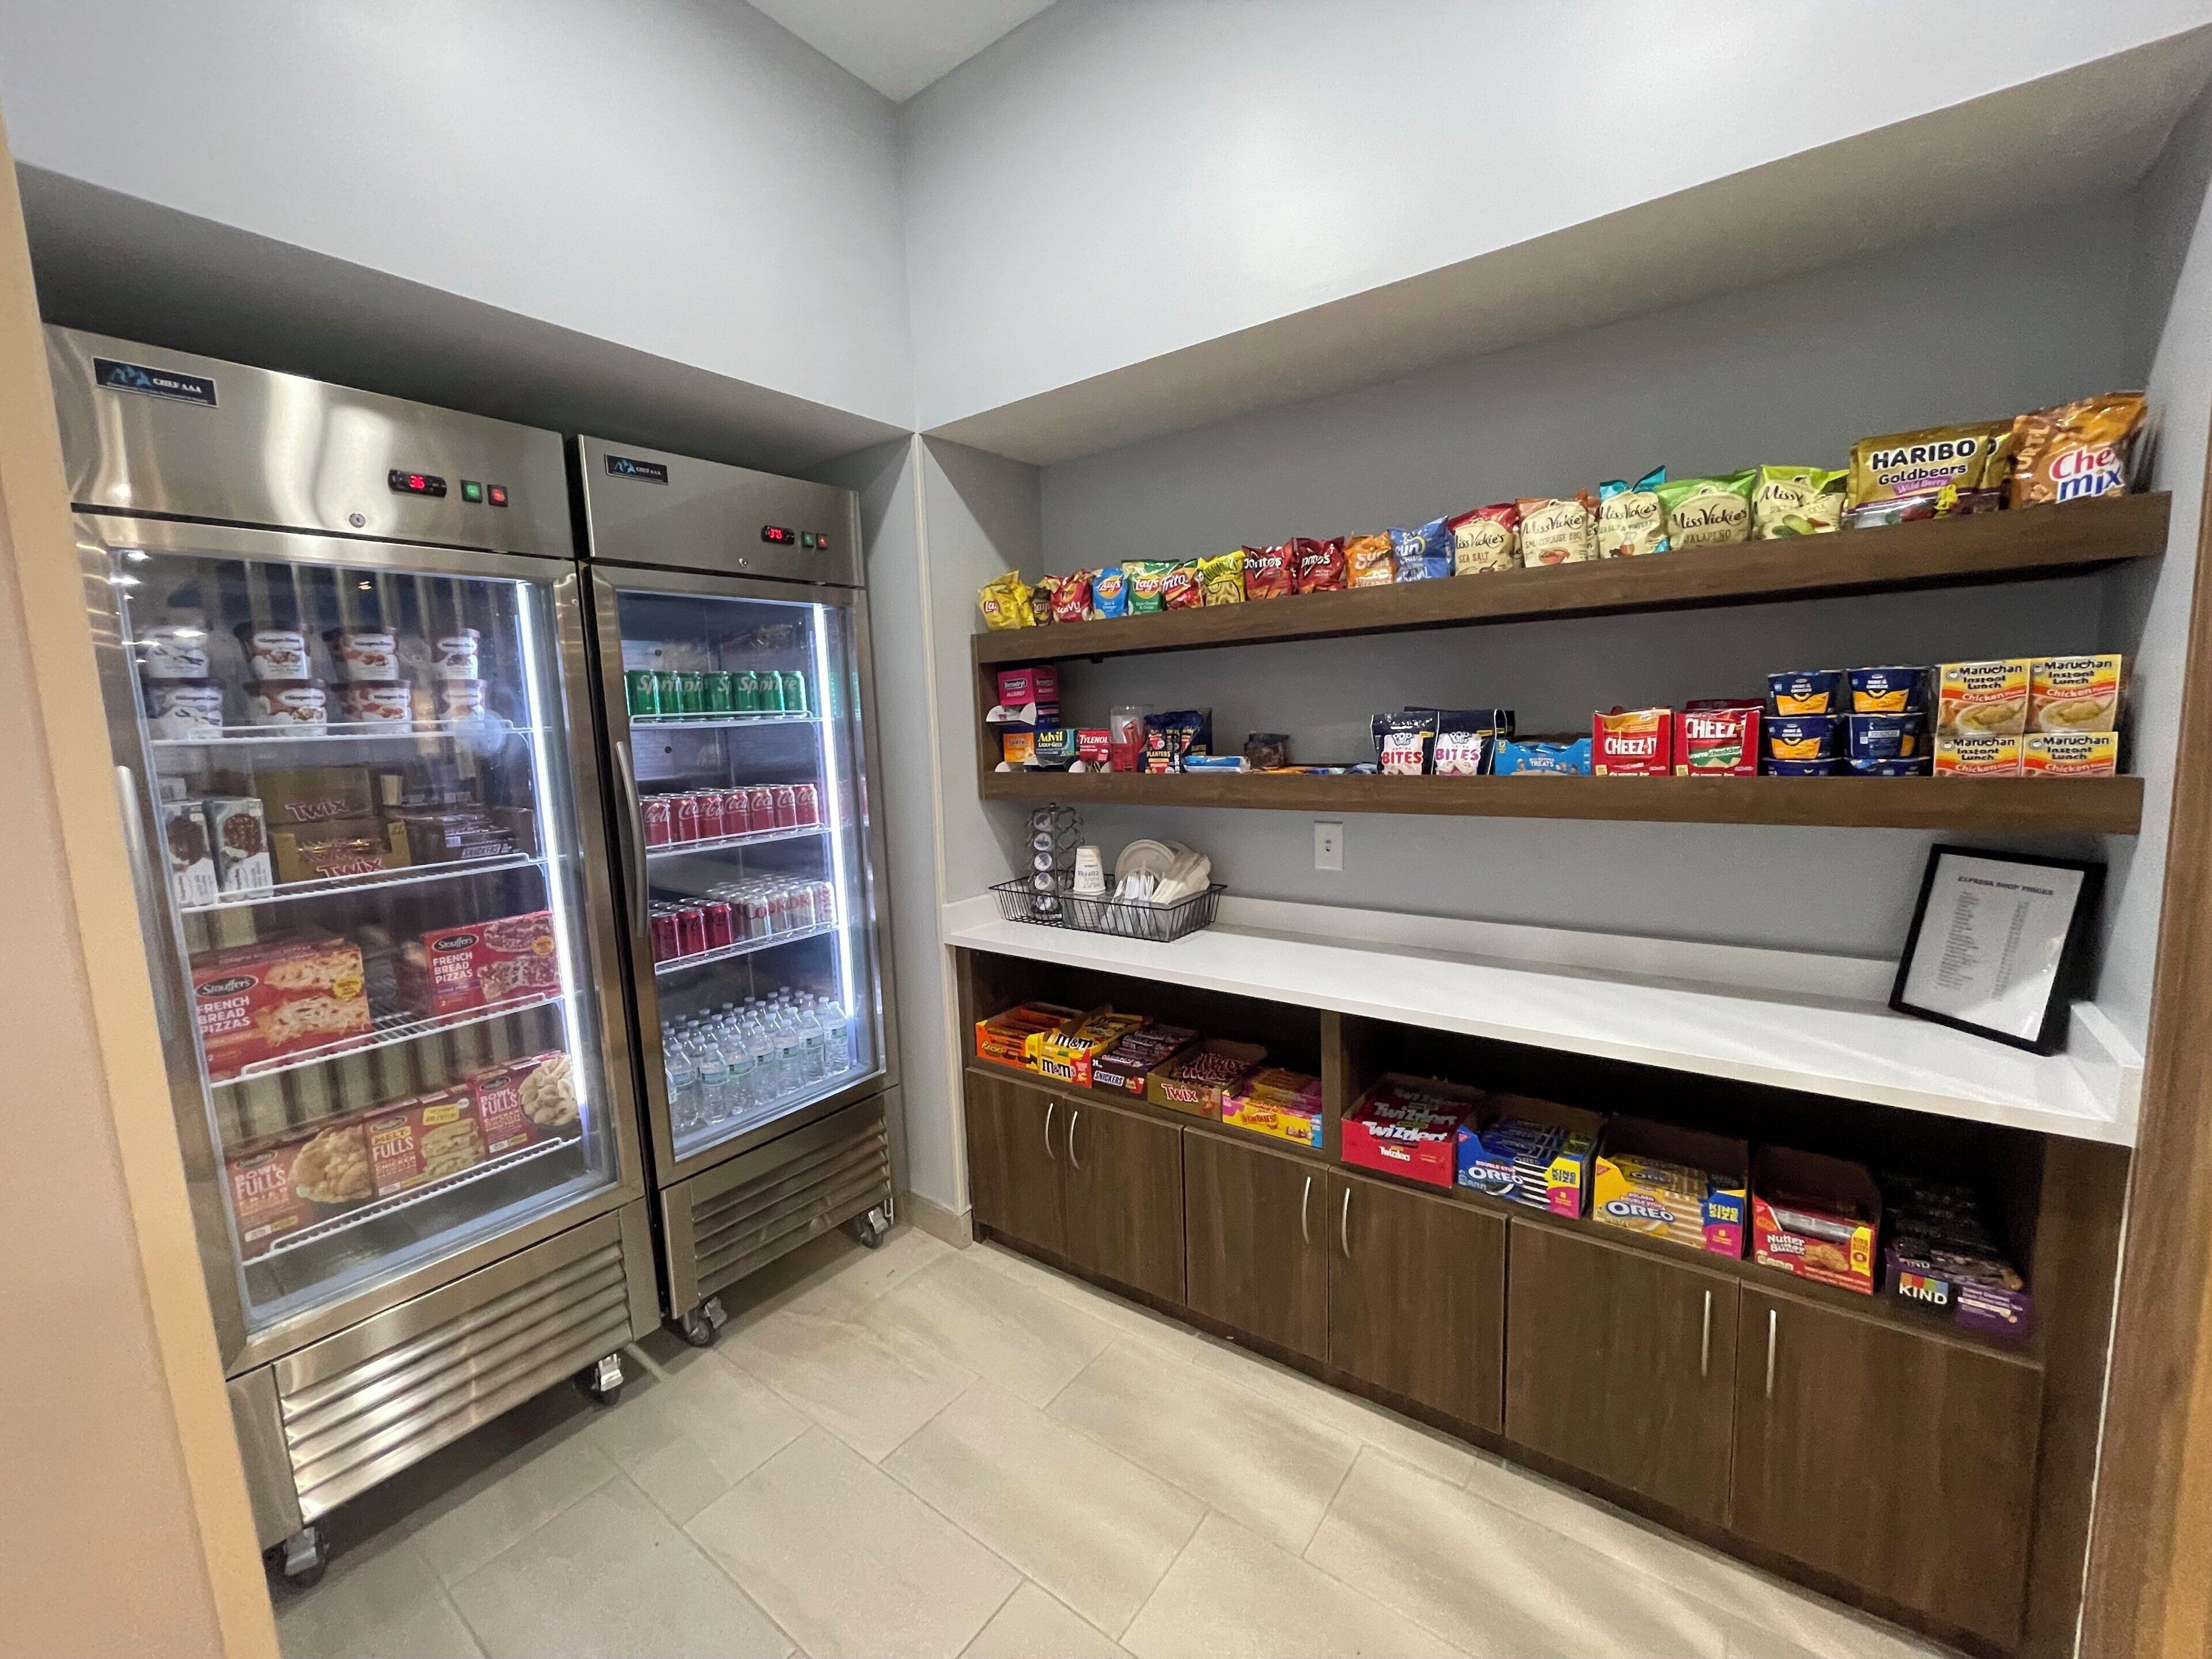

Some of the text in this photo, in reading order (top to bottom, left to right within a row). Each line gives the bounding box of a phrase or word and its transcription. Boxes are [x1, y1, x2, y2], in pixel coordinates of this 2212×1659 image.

[1872, 439, 1976, 471] HARIBO
[1878, 463, 1967, 486] Goldbears
[1897, 477, 1948, 495] Wild Berry
[2060, 467, 2124, 501] mix
[1760, 486, 1795, 503] Miss
[1672, 512, 1702, 529] Miss
[1699, 503, 1747, 526] Vickie's
[1521, 520, 1550, 537] Miss
[1459, 551, 1489, 563] SEA SALT
[1160, 574, 1188, 592] Frito
[1960, 665, 2022, 676] Maruchan
[2044, 660, 2112, 670] Maruchan
[1964, 676, 2006, 684] Instant
[1962, 691, 2005, 702] Chicken
[2046, 688, 2092, 698] Chicken
[1038, 731, 1063, 742] Advil
[1080, 734, 1108, 744] TYLENOL
[1953, 738, 2015, 747] Maruchan
[2043, 736, 2109, 745] Maruchan
[1382, 751, 1422, 764] BITES
[1435, 748, 1479, 760] BITES
[1955, 764, 1998, 772] Chicken
[2045, 764, 2090, 772] Chicken
[433, 951, 472, 967] FRENCH
[434, 961, 469, 975] BREAD
[435, 969, 473, 984] PIZZAS
[196, 996, 249, 1014] FRENCH
[198, 1007, 245, 1025] BREAD
[201, 1017, 251, 1033] PIZZAS
[1094, 1071, 1123, 1085] SNICKERS
[1161, 1083, 1198, 1103] Twix
[482, 1094, 518, 1117] FULLS
[1242, 1113, 1277, 1125] Starburst
[373, 1137, 414, 1161] FULLS
[1468, 1166, 1524, 1185] OREO
[1552, 1168, 1575, 1178] KING
[1552, 1173, 1576, 1185] SIZE
[236, 1169, 286, 1199] FULLS
[1606, 1200, 1674, 1222] OREO
[1709, 1203, 1738, 1215] KING
[1709, 1210, 1738, 1223] SIZE
[1767, 1234, 1805, 1247] Nutter
[1770, 1243, 1805, 1256] Butter
[1899, 1283, 1948, 1305] KIND
